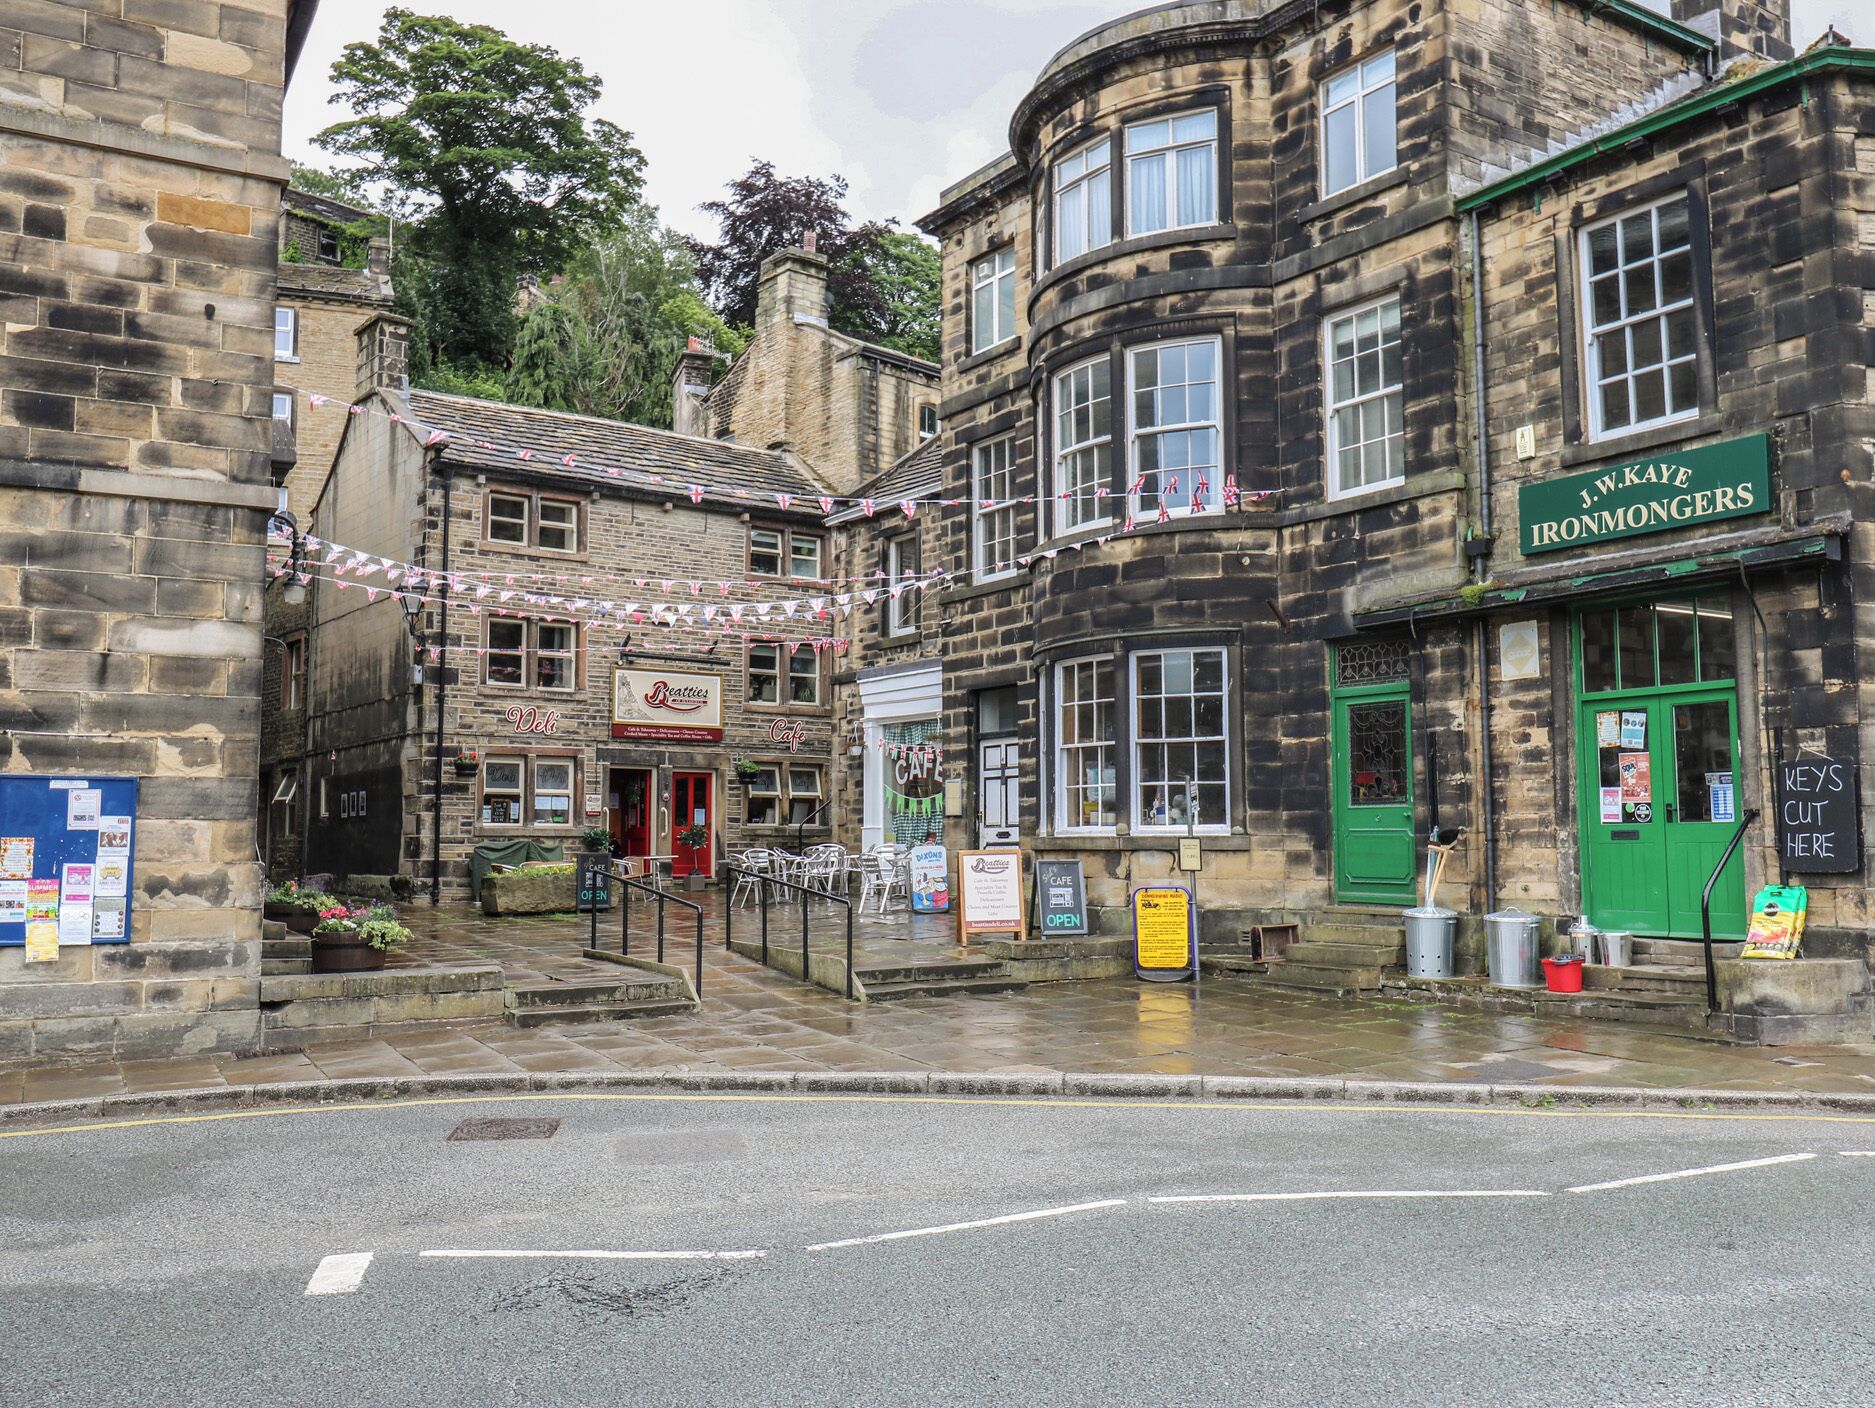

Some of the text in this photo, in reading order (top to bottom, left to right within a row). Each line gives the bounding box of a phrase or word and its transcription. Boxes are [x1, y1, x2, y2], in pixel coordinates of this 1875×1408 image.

[1530, 482, 1755, 547] IRONMONGERS
[644, 680, 709, 712] Beatties
[506, 705, 560, 735] Deli
[770, 718, 807, 753] Cafe
[1785, 764, 1843, 792] KEYS
[1784, 800, 1829, 826] CUT
[915, 851, 943, 863] DIXONS
[1787, 832, 1835, 858] HERE
[971, 857, 1009, 874] Beatties
[1050, 876, 1073, 885] CAFE
[1047, 914, 1080, 927] OPEN
